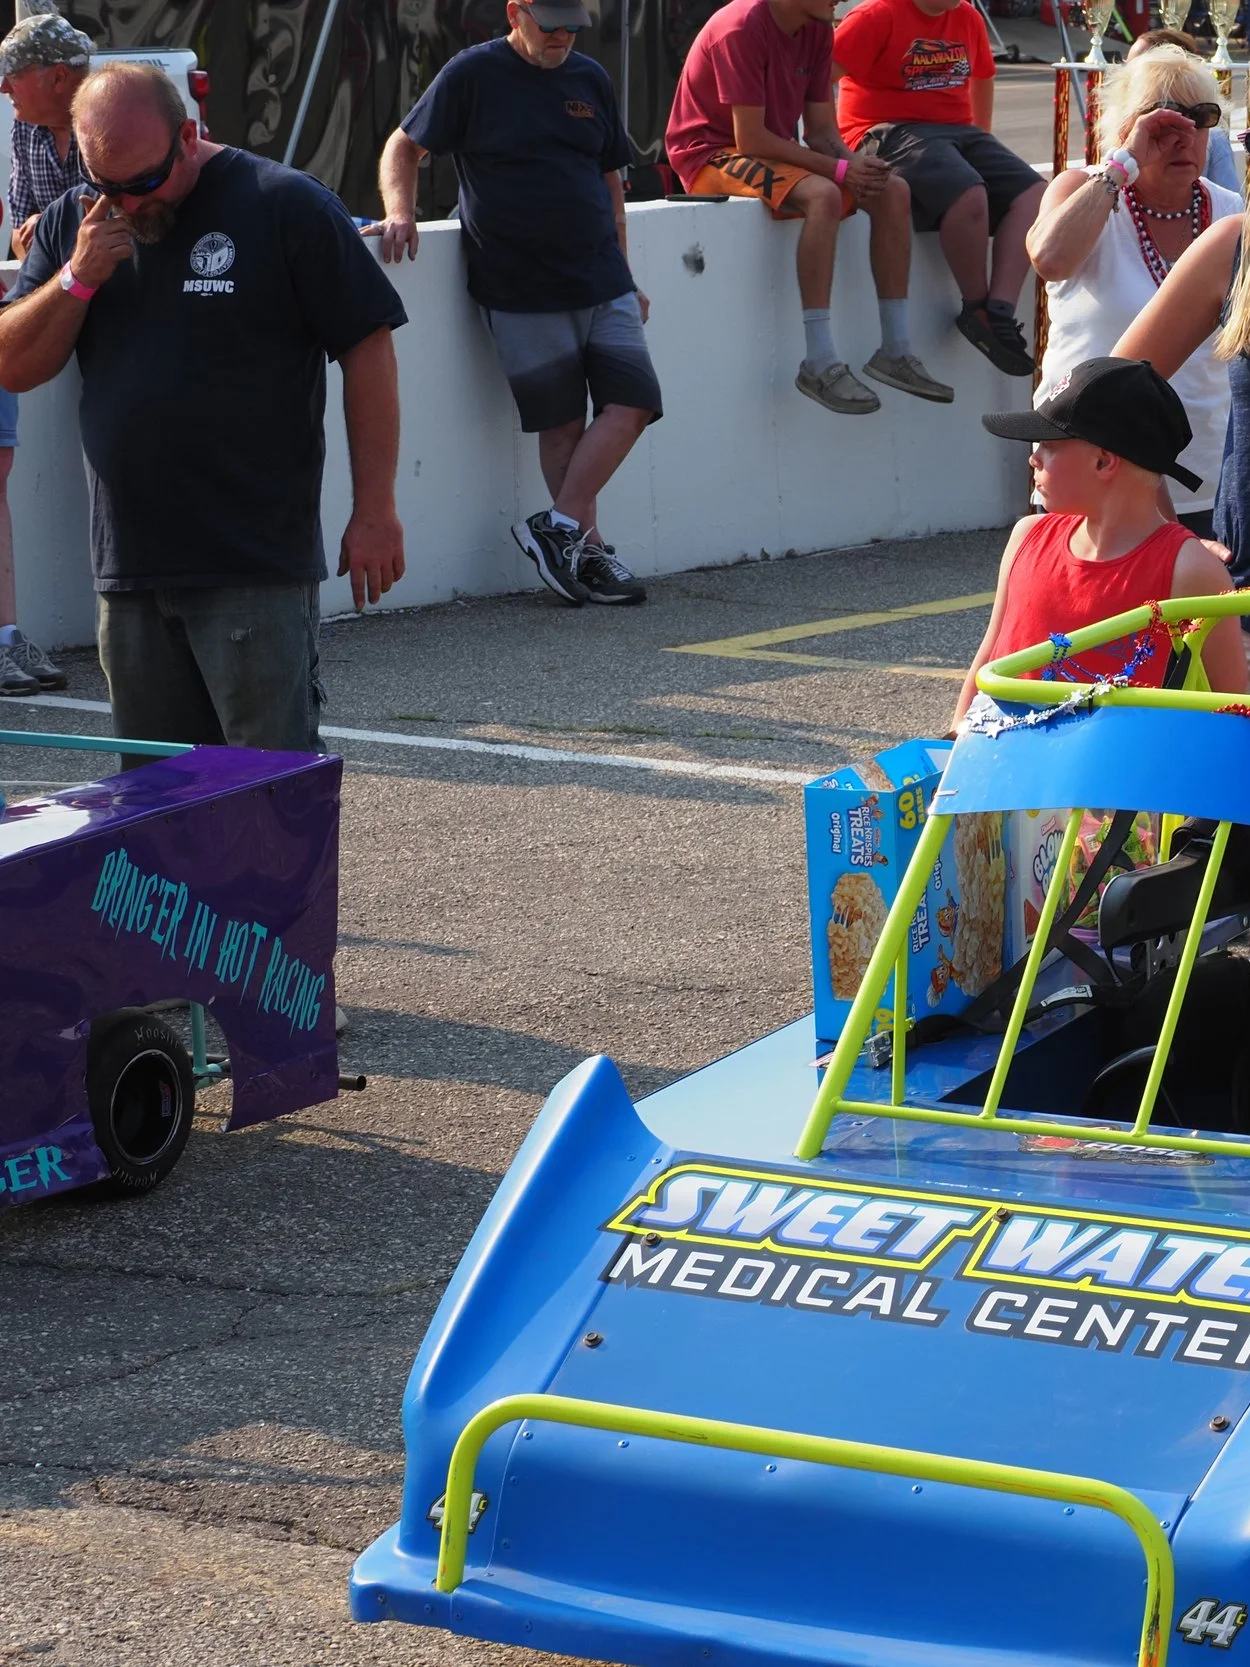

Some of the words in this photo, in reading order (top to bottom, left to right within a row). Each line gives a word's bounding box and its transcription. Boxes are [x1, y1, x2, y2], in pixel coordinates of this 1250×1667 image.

[183, 280, 234, 293] MSUWC
[849, 808, 865, 865] TREATS
[861, 806, 871, 827] RICE
[864, 827, 873, 867] KRISPIES
[184, 902, 217, 977] IN
[215, 920, 268, 1005] HOT
[257, 937, 325, 1038] RACING
[637, 1174, 976, 1259] SWEET
[609, 1243, 941, 1322] MEDICAL
